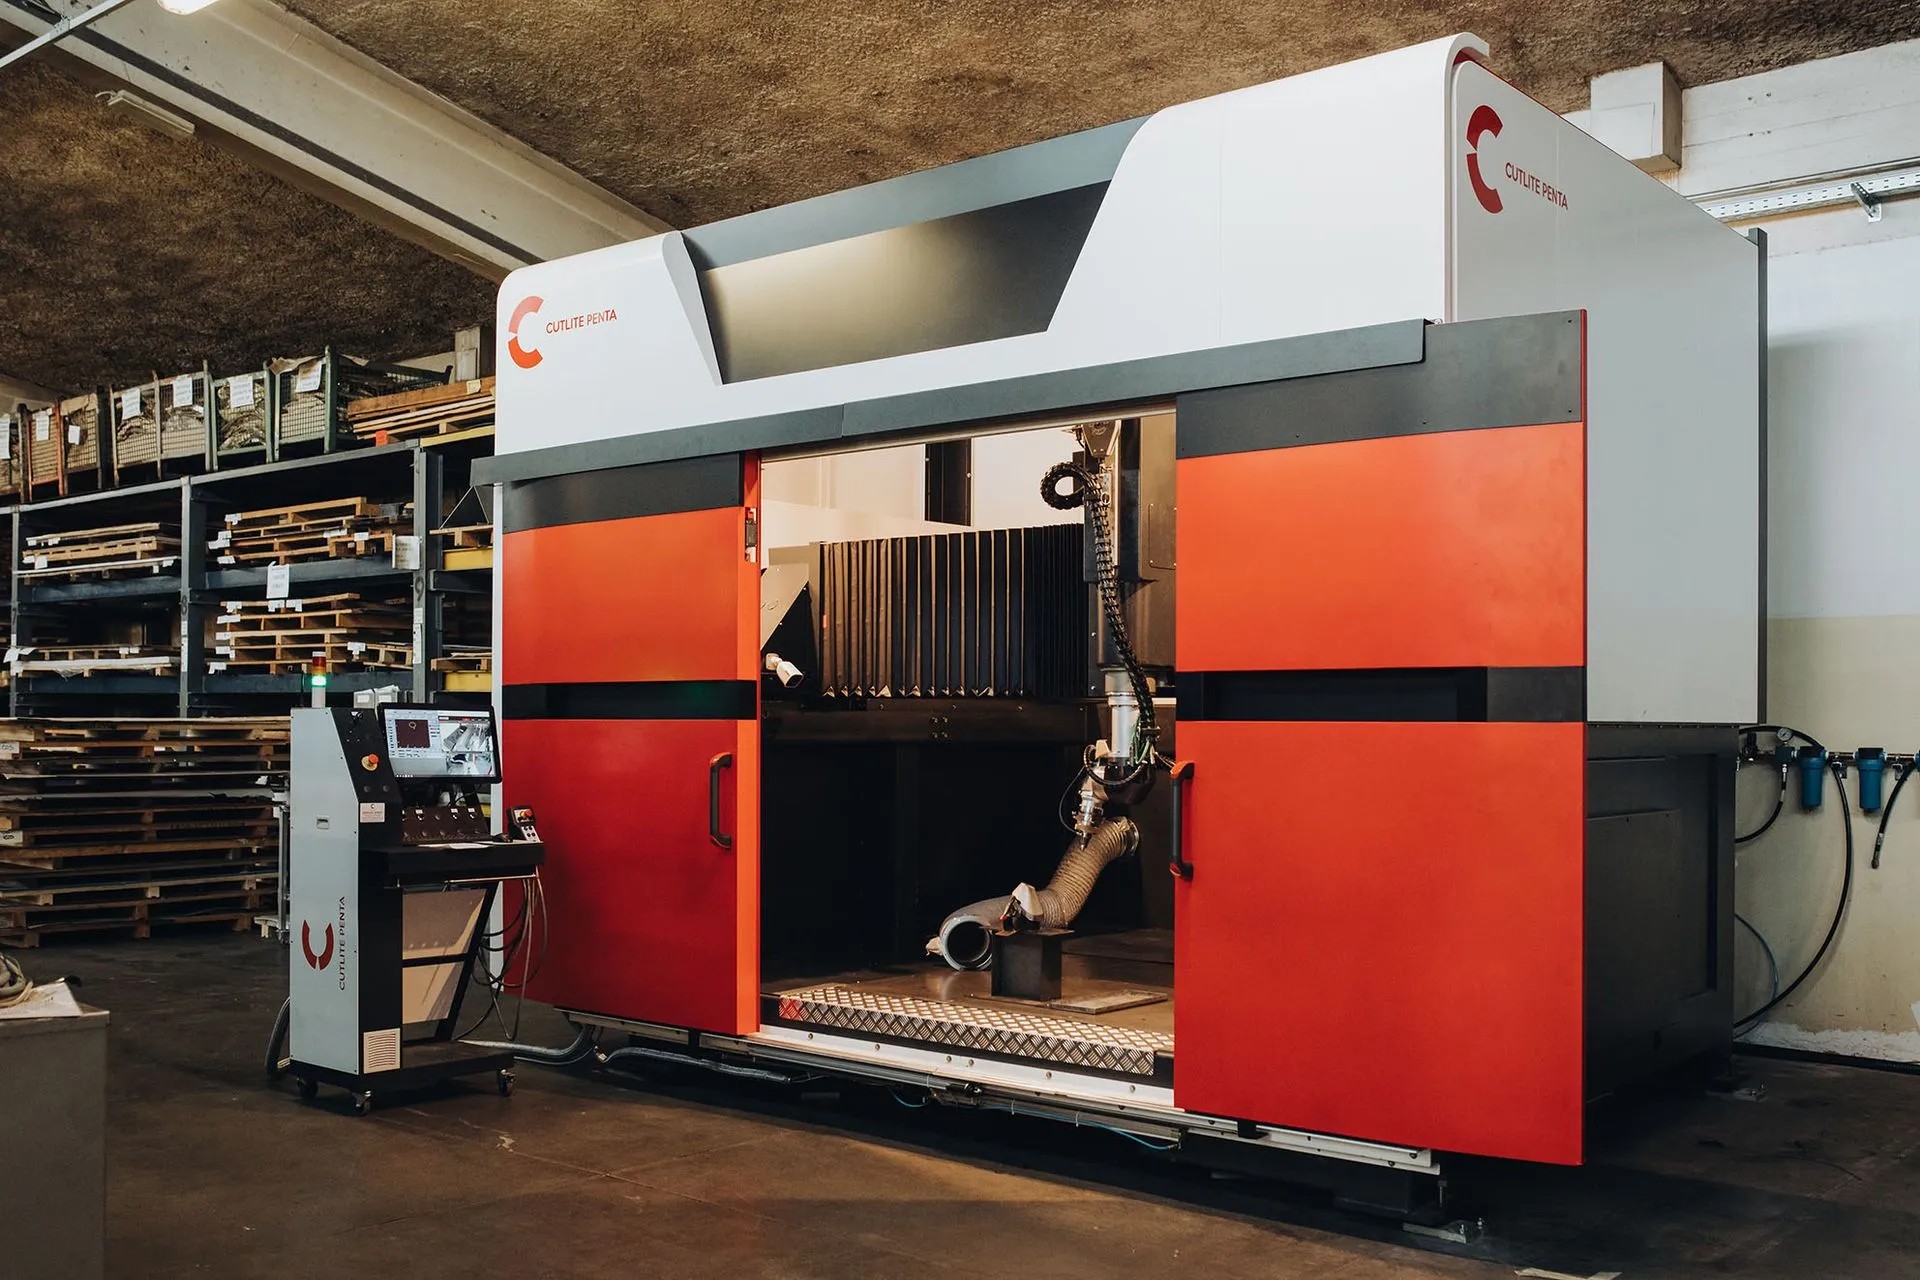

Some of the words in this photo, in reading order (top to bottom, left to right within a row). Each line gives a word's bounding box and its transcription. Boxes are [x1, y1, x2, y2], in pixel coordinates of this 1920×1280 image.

[1505, 162, 1540, 194] CUTLITE
[1542, 183, 1568, 210] PENTA
[546, 316, 584, 333] CUTLITE
[587, 309, 617, 326] PENTA
